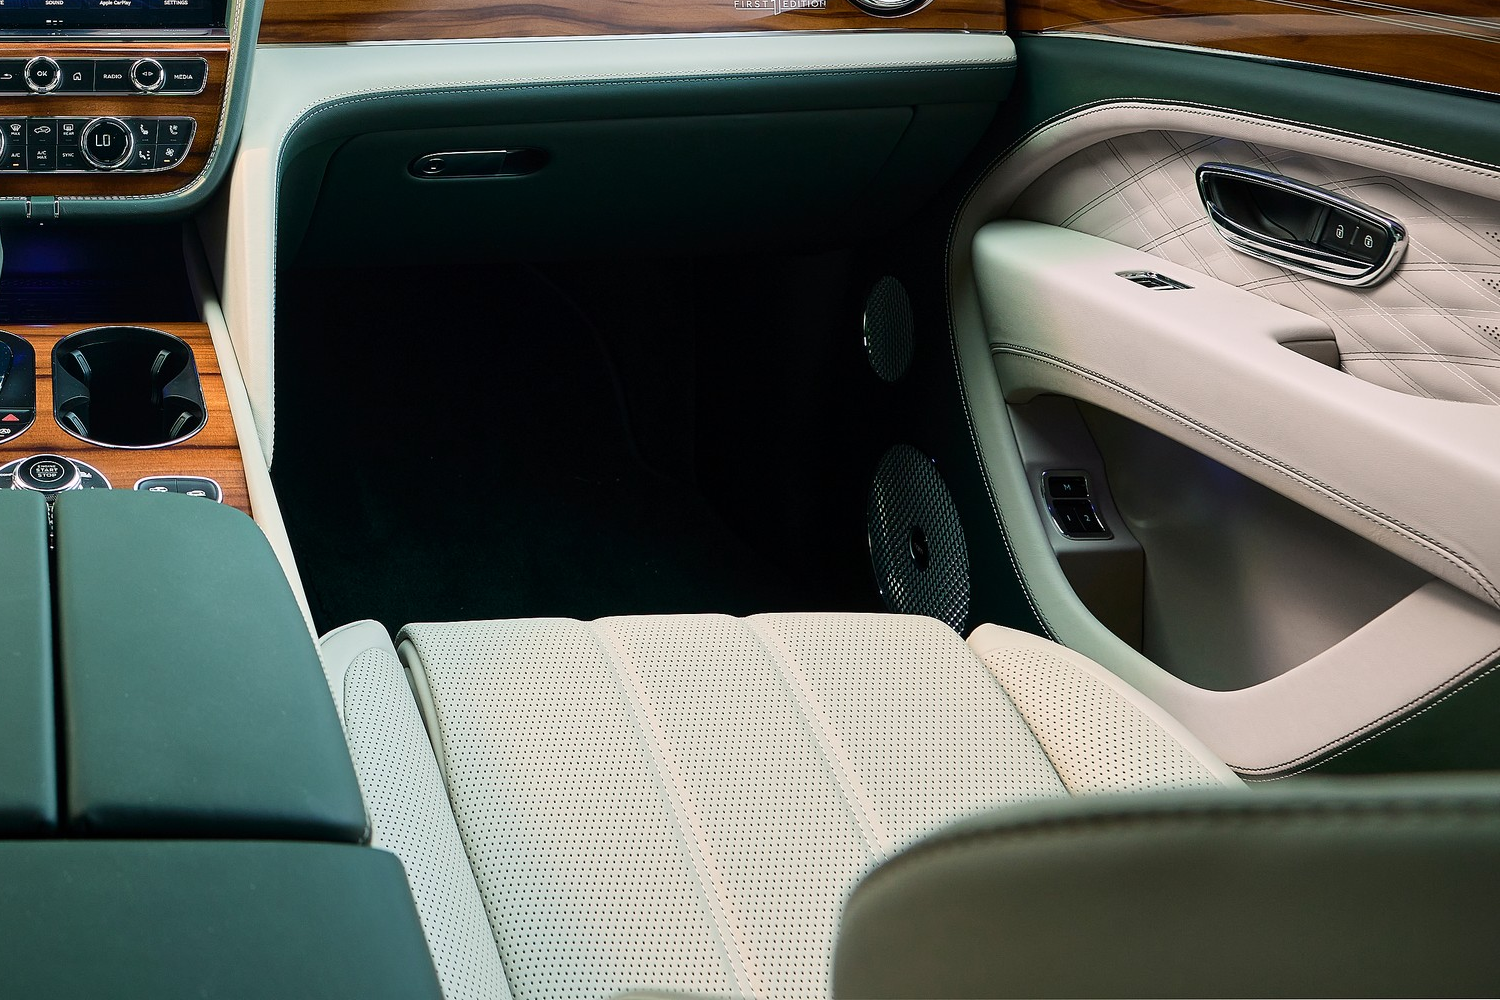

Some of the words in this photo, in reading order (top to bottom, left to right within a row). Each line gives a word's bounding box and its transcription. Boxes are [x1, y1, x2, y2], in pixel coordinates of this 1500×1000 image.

[734, 0, 768, 8] FIRST
[783, 0, 827, 8] EDITION
[96, 134, 111, 147] LO
[1083, 514, 1091, 522] 2
